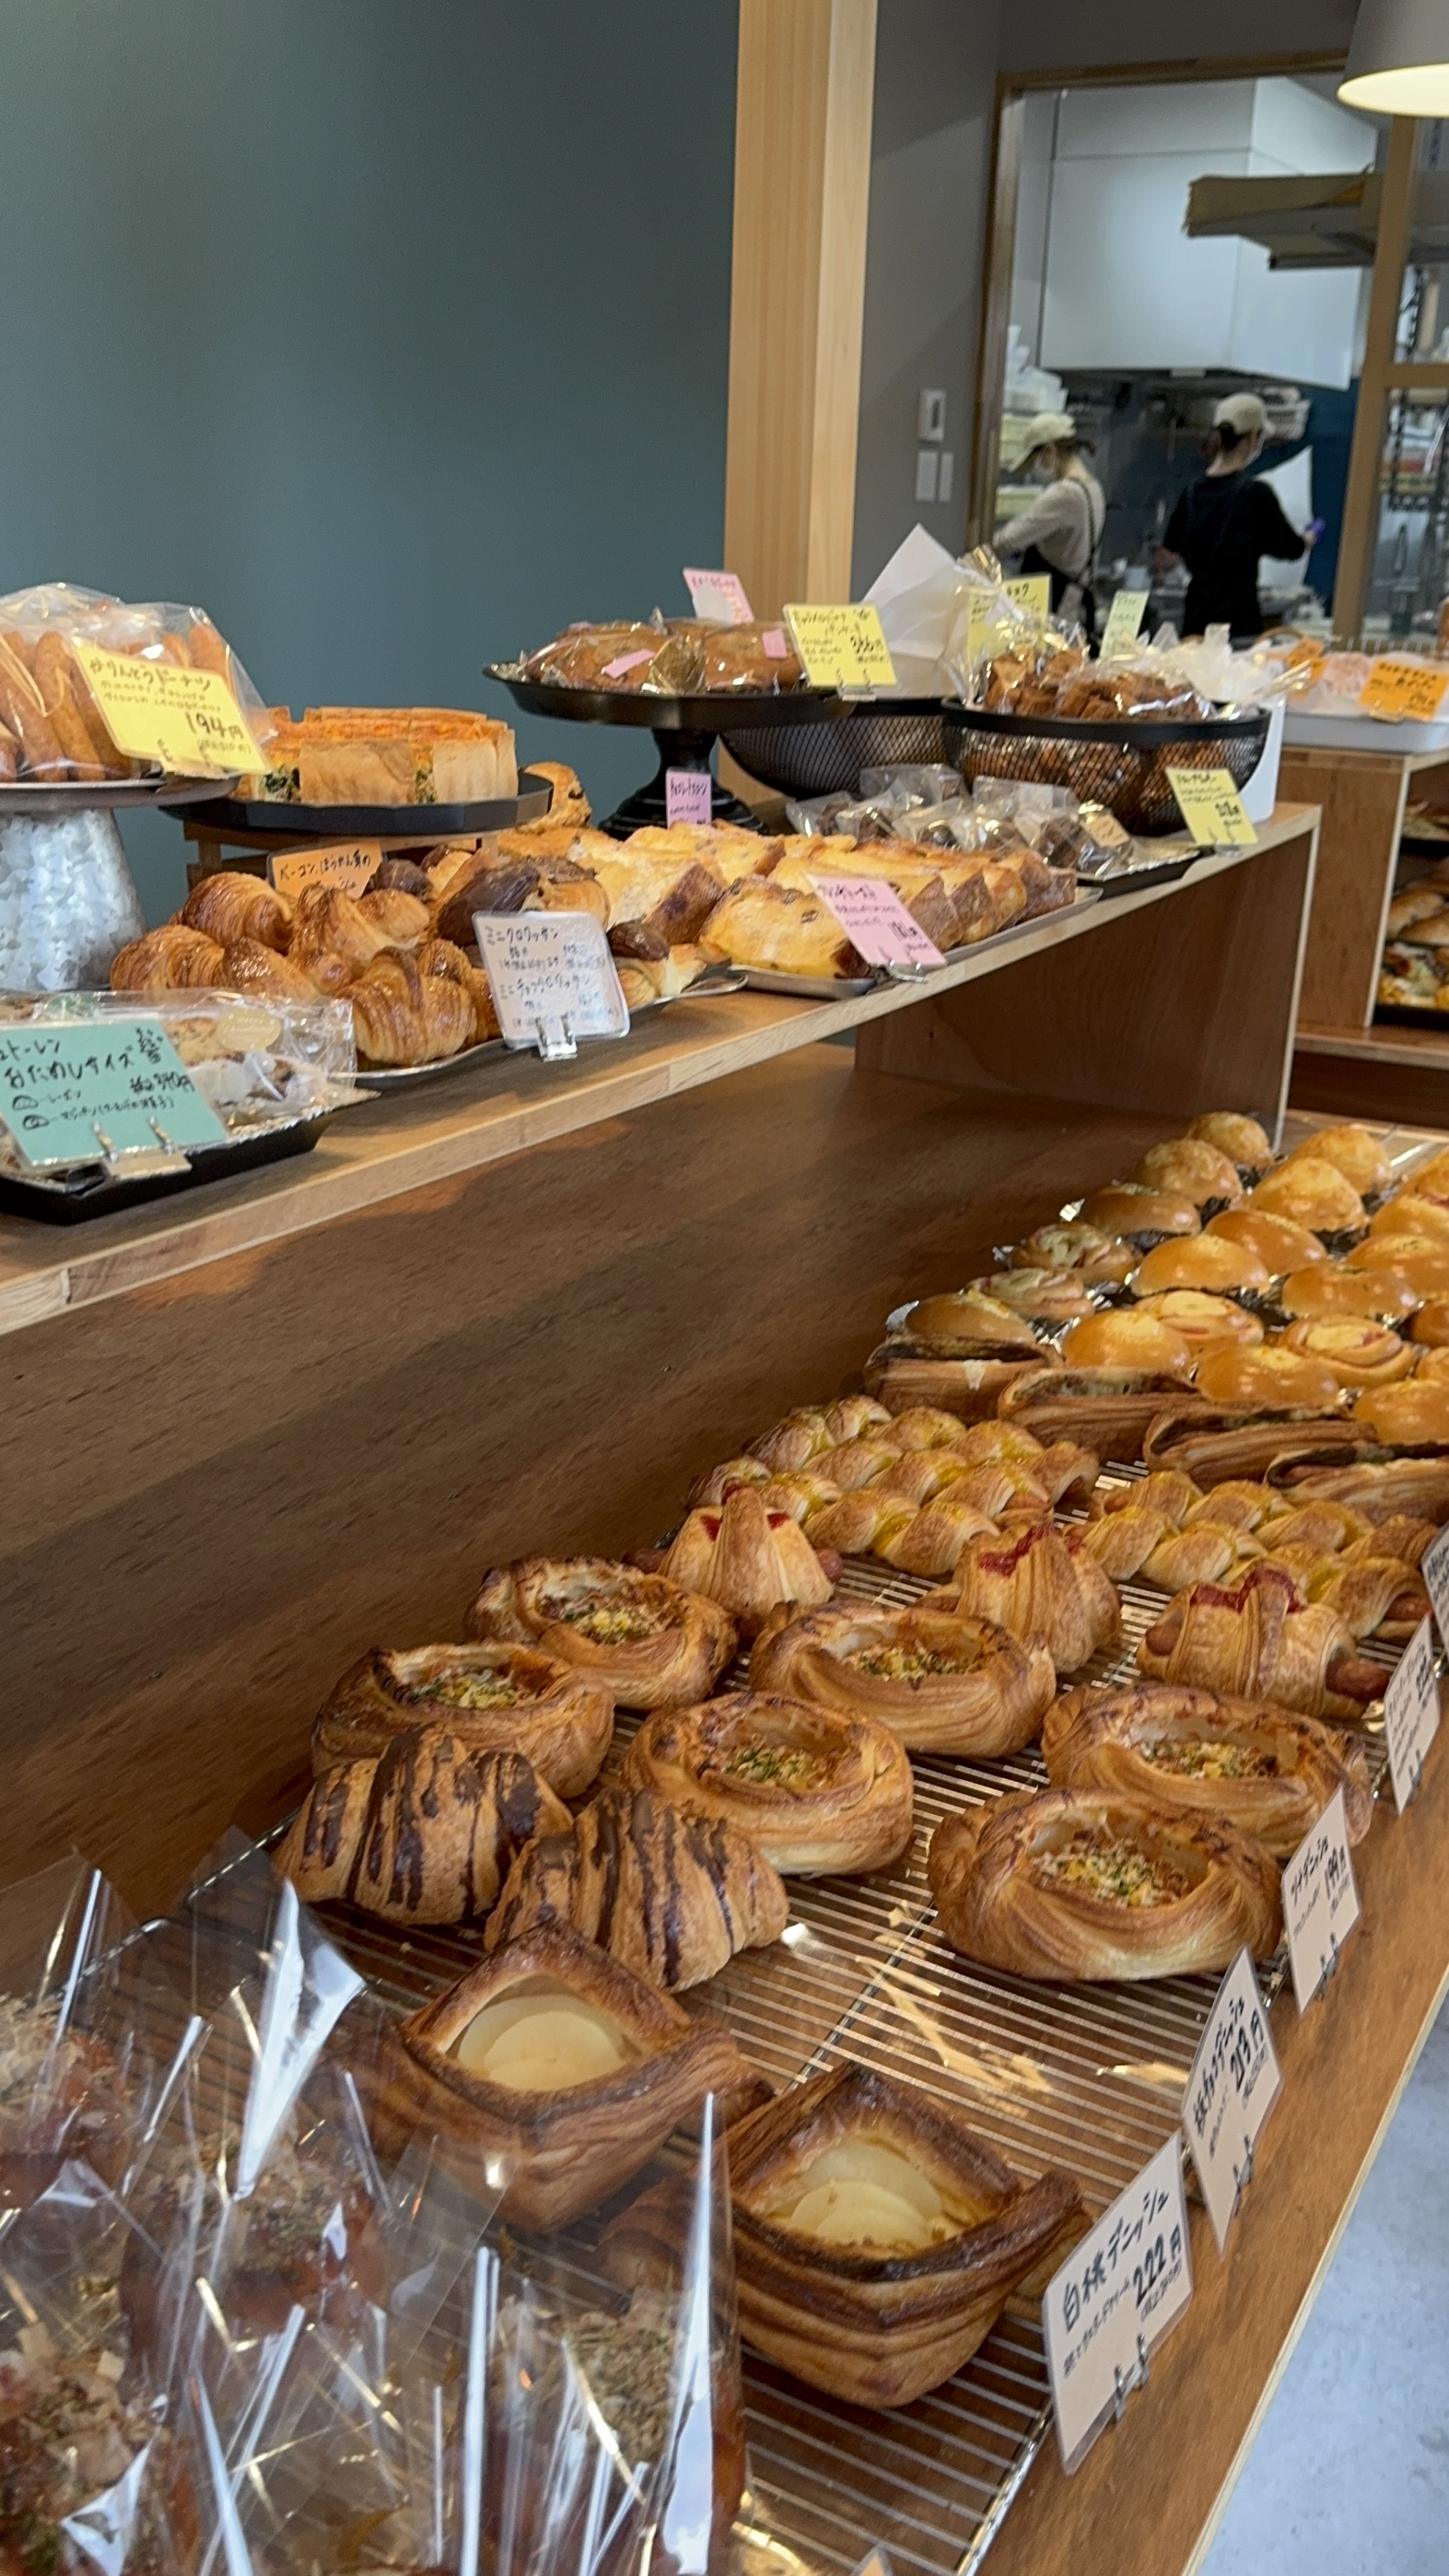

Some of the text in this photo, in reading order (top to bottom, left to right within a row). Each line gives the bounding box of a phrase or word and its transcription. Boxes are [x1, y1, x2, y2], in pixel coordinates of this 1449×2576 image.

[5, 1044, 135, 1089] おためしサイズ
[1230, 2007, 1265, 2094] 213円
[1063, 2187, 1170, 2334] 白桃デニッシュ
[1132, 2222, 1183, 2310] 222円
